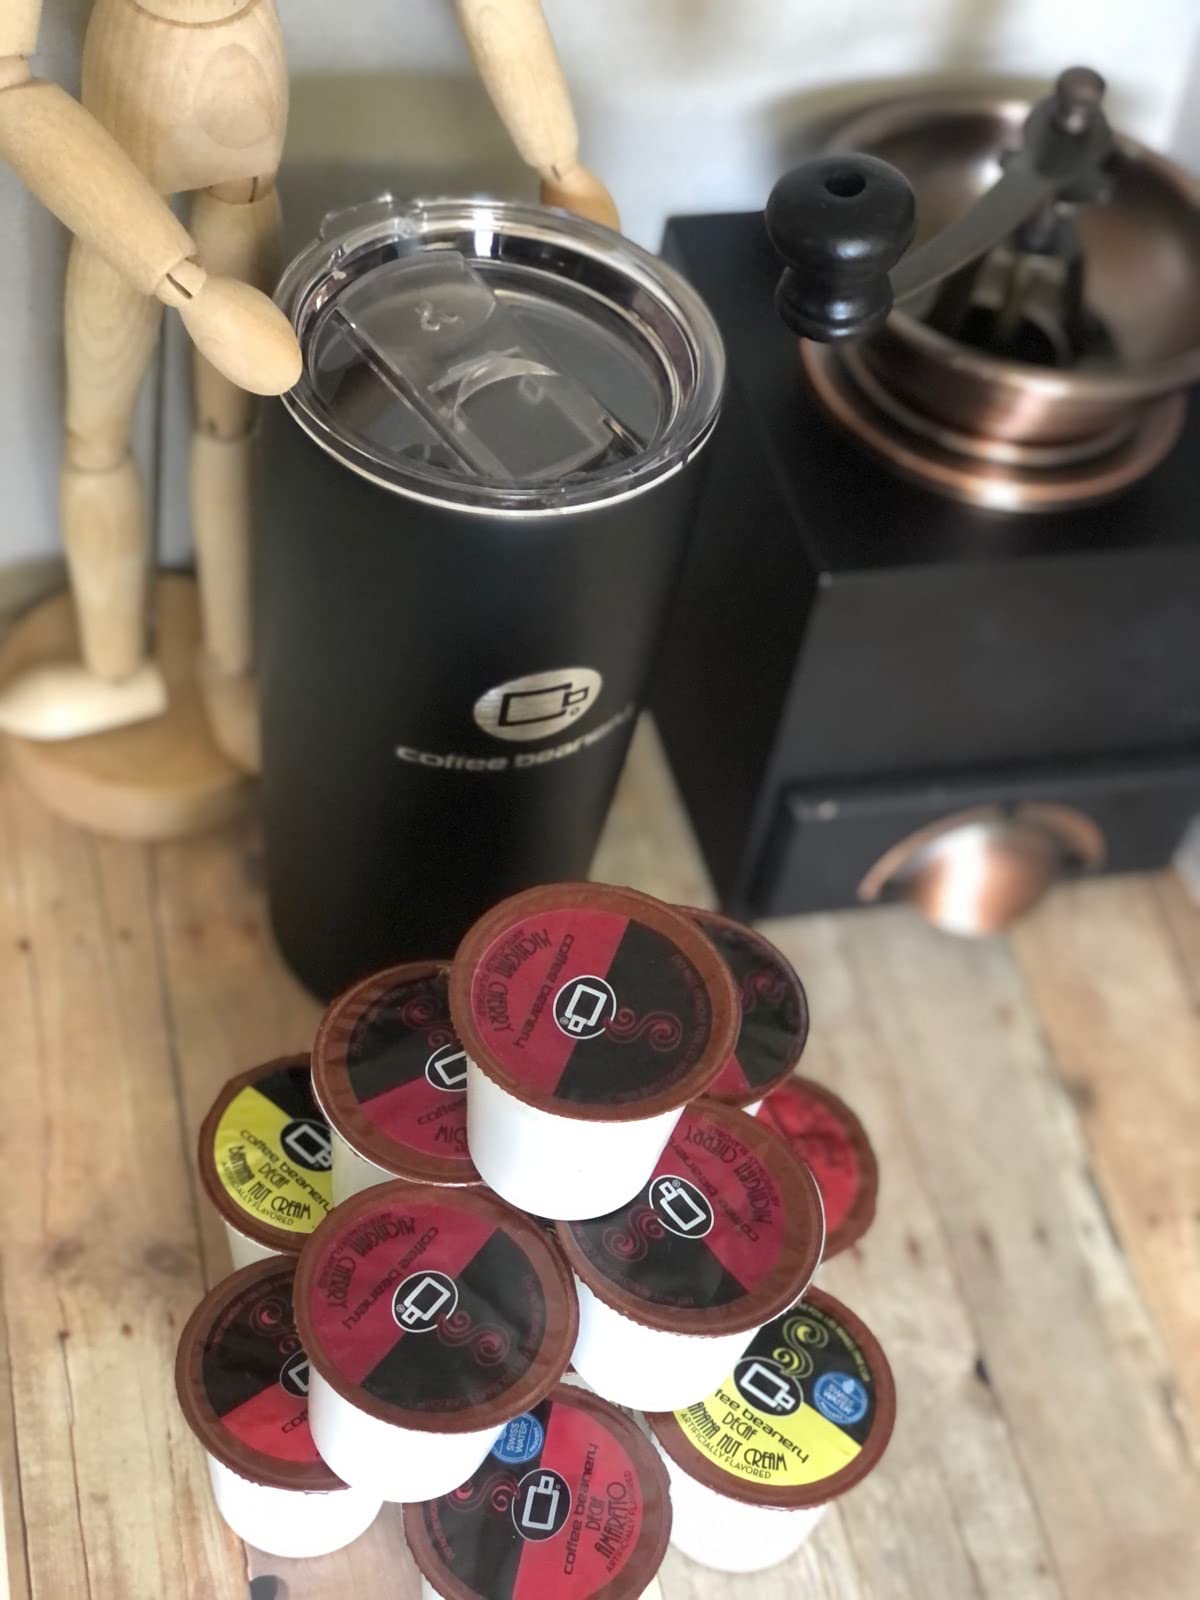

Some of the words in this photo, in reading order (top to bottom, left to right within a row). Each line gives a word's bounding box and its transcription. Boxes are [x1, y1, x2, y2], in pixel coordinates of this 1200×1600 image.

[396, 745, 508, 771] coffee
[547, 933, 576, 983] coffee
[513, 984, 554, 1048] beanery
[240, 1129, 280, 1163] coffee
[279, 1161, 329, 1213] beanery
[258, 1162, 290, 1189] DECAF
[247, 1181, 272, 1203] NUT
[271, 1195, 311, 1220] CREAM
[398, 1226, 439, 1269] coffee
[515, 1421, 528, 1453] WATER
[680, 1413, 725, 1459] ARTIFICIALLY
[724, 1456, 772, 1479] FLAVORED
[687, 1401, 721, 1439] ANANA
[716, 1433, 743, 1458] NUT
[743, 1448, 787, 1471] CREAM
[715, 1388, 741, 1410] fee
[742, 1408, 809, 1464] beanery
[721, 1411, 758, 1441] DECAF
[563, 1519, 583, 1575] coffee
[573, 1442, 599, 1516] beanery
[594, 1481, 629, 1560] AMARETTO
